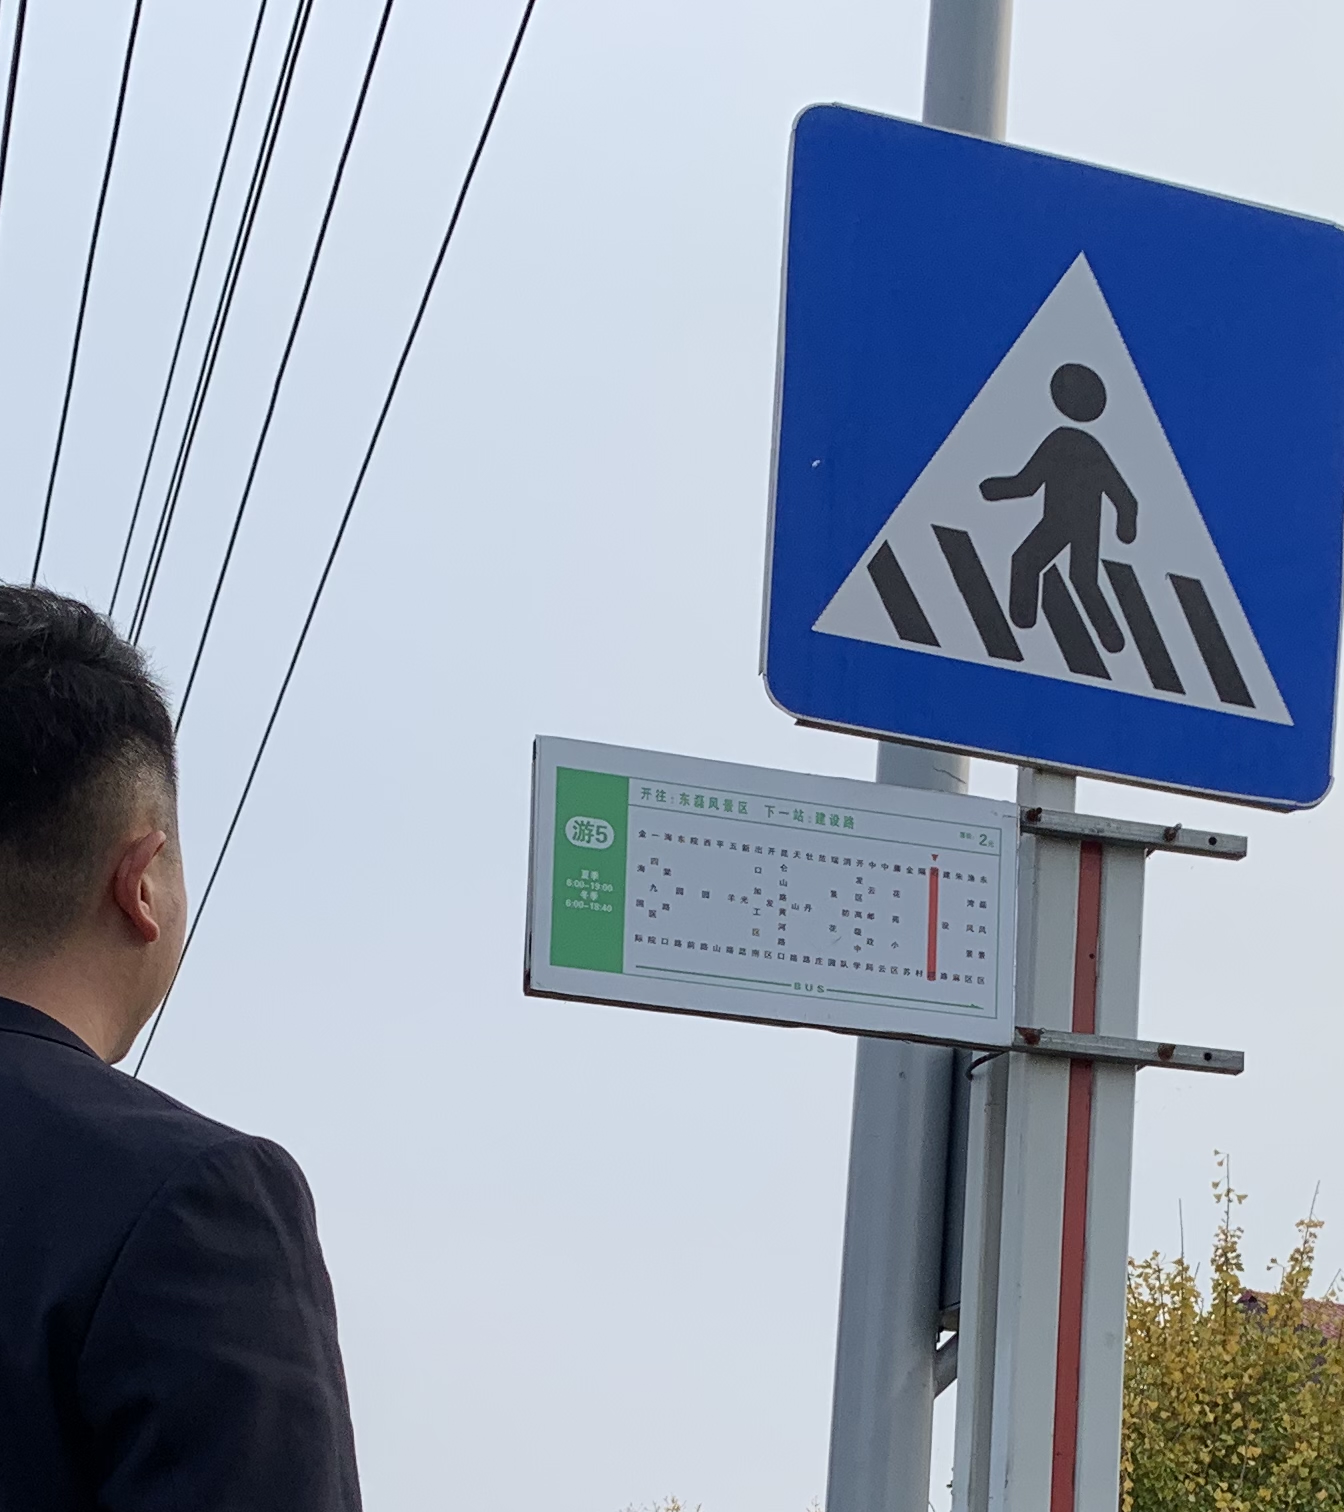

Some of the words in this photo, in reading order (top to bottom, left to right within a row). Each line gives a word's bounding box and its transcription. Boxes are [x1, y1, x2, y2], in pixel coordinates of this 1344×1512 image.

[572, 820, 608, 844] 游5
[878, 863, 889, 973] 中云
[793, 982, 825, 993] BUS
